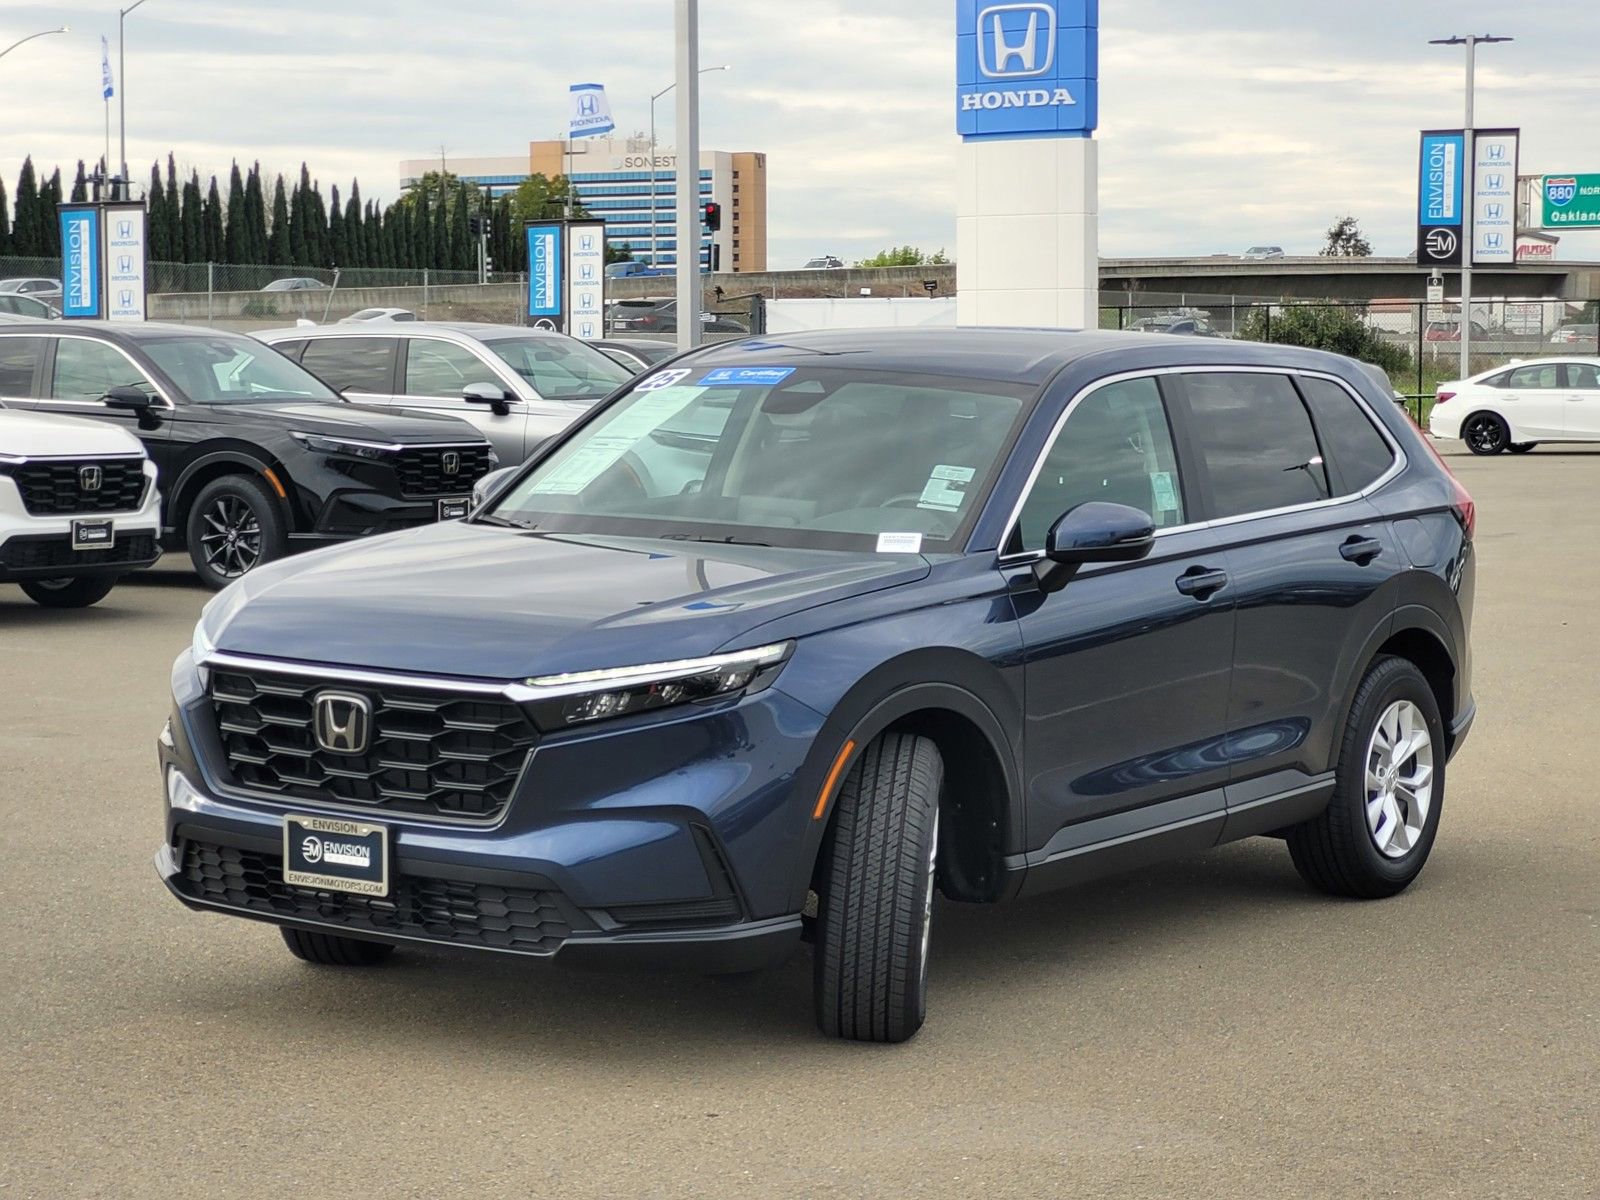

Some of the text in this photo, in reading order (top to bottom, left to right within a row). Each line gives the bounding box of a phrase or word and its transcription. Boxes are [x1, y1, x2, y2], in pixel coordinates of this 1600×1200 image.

[961, 88, 1076, 111] HONDA
[570, 115, 610, 128] HONDA
[1428, 143, 1445, 218] ENVISION
[1549, 186, 1574, 200] 880
[68, 219, 82, 308] ENVISION
[535, 234, 546, 309] ENVISION
[637, 372, 687, 389] 25
[312, 819, 358, 834] ENVISION
[323, 841, 370, 857] ENVISION
[288, 873, 383, 894] ENVISIONMOTORS.COM
